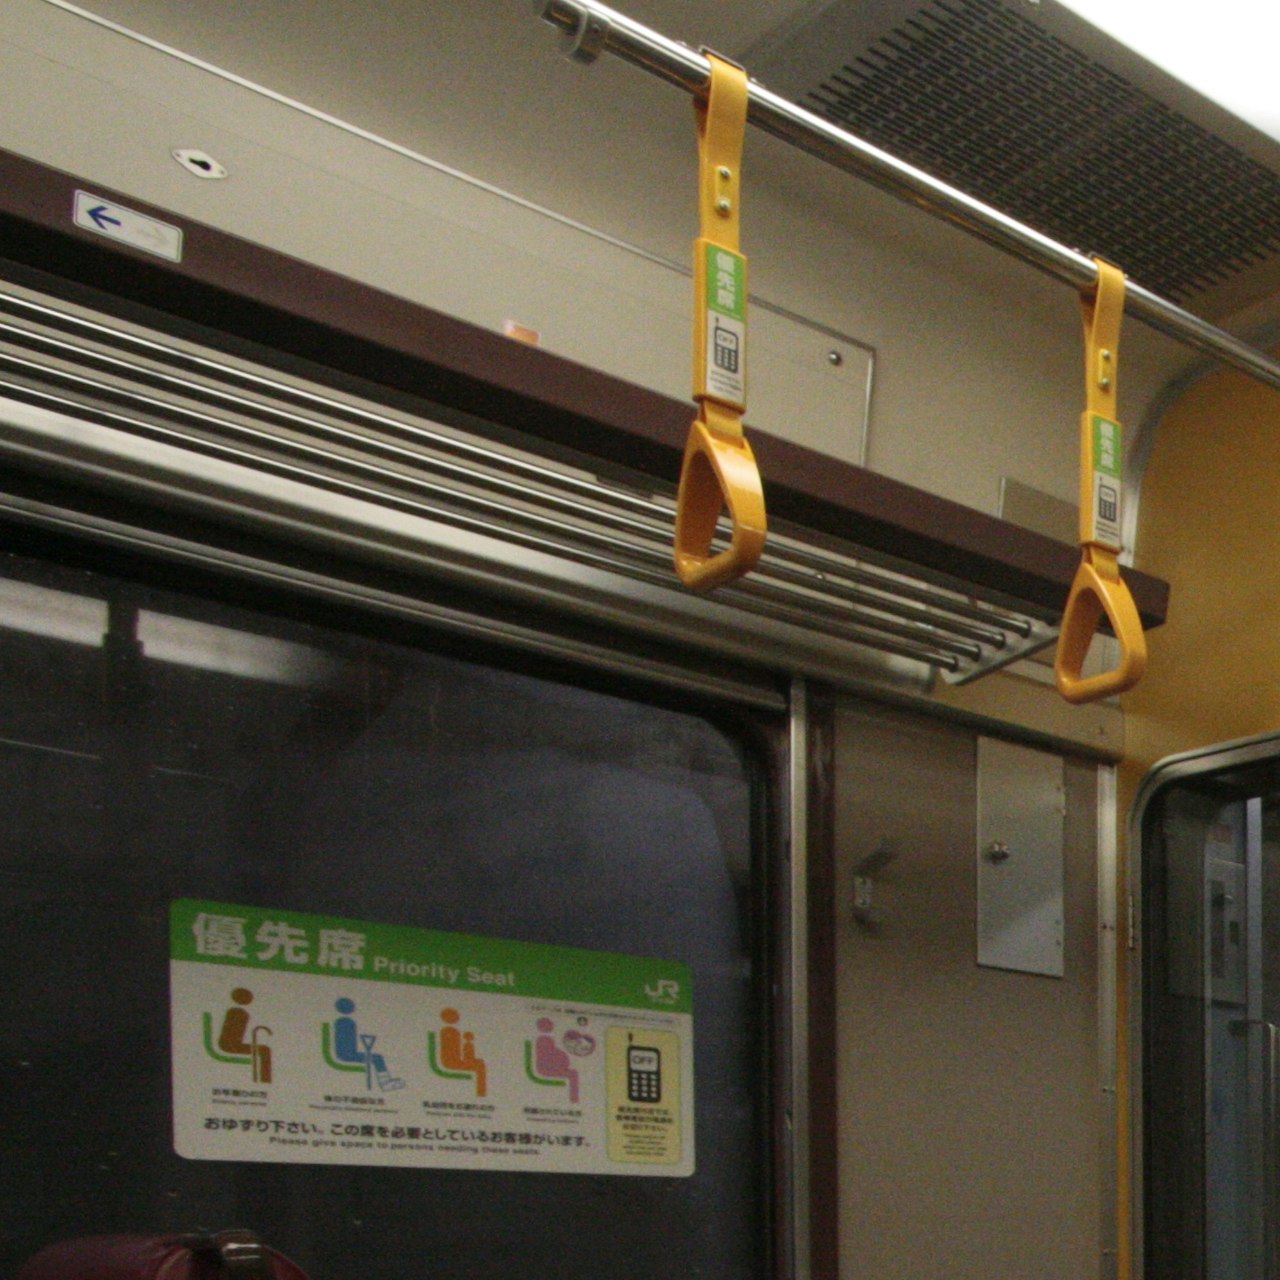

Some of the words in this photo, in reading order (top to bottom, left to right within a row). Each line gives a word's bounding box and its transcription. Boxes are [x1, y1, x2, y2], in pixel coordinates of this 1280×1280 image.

[193, 911, 366, 971] 優先席
[373, 956, 460, 988] Priority
[466, 963, 516, 989] Seat
[644, 980, 680, 999] JR
[269, 1136, 308, 1147] Please
[312, 1139, 336, 1148] give
[341, 1140, 373, 1150] space
